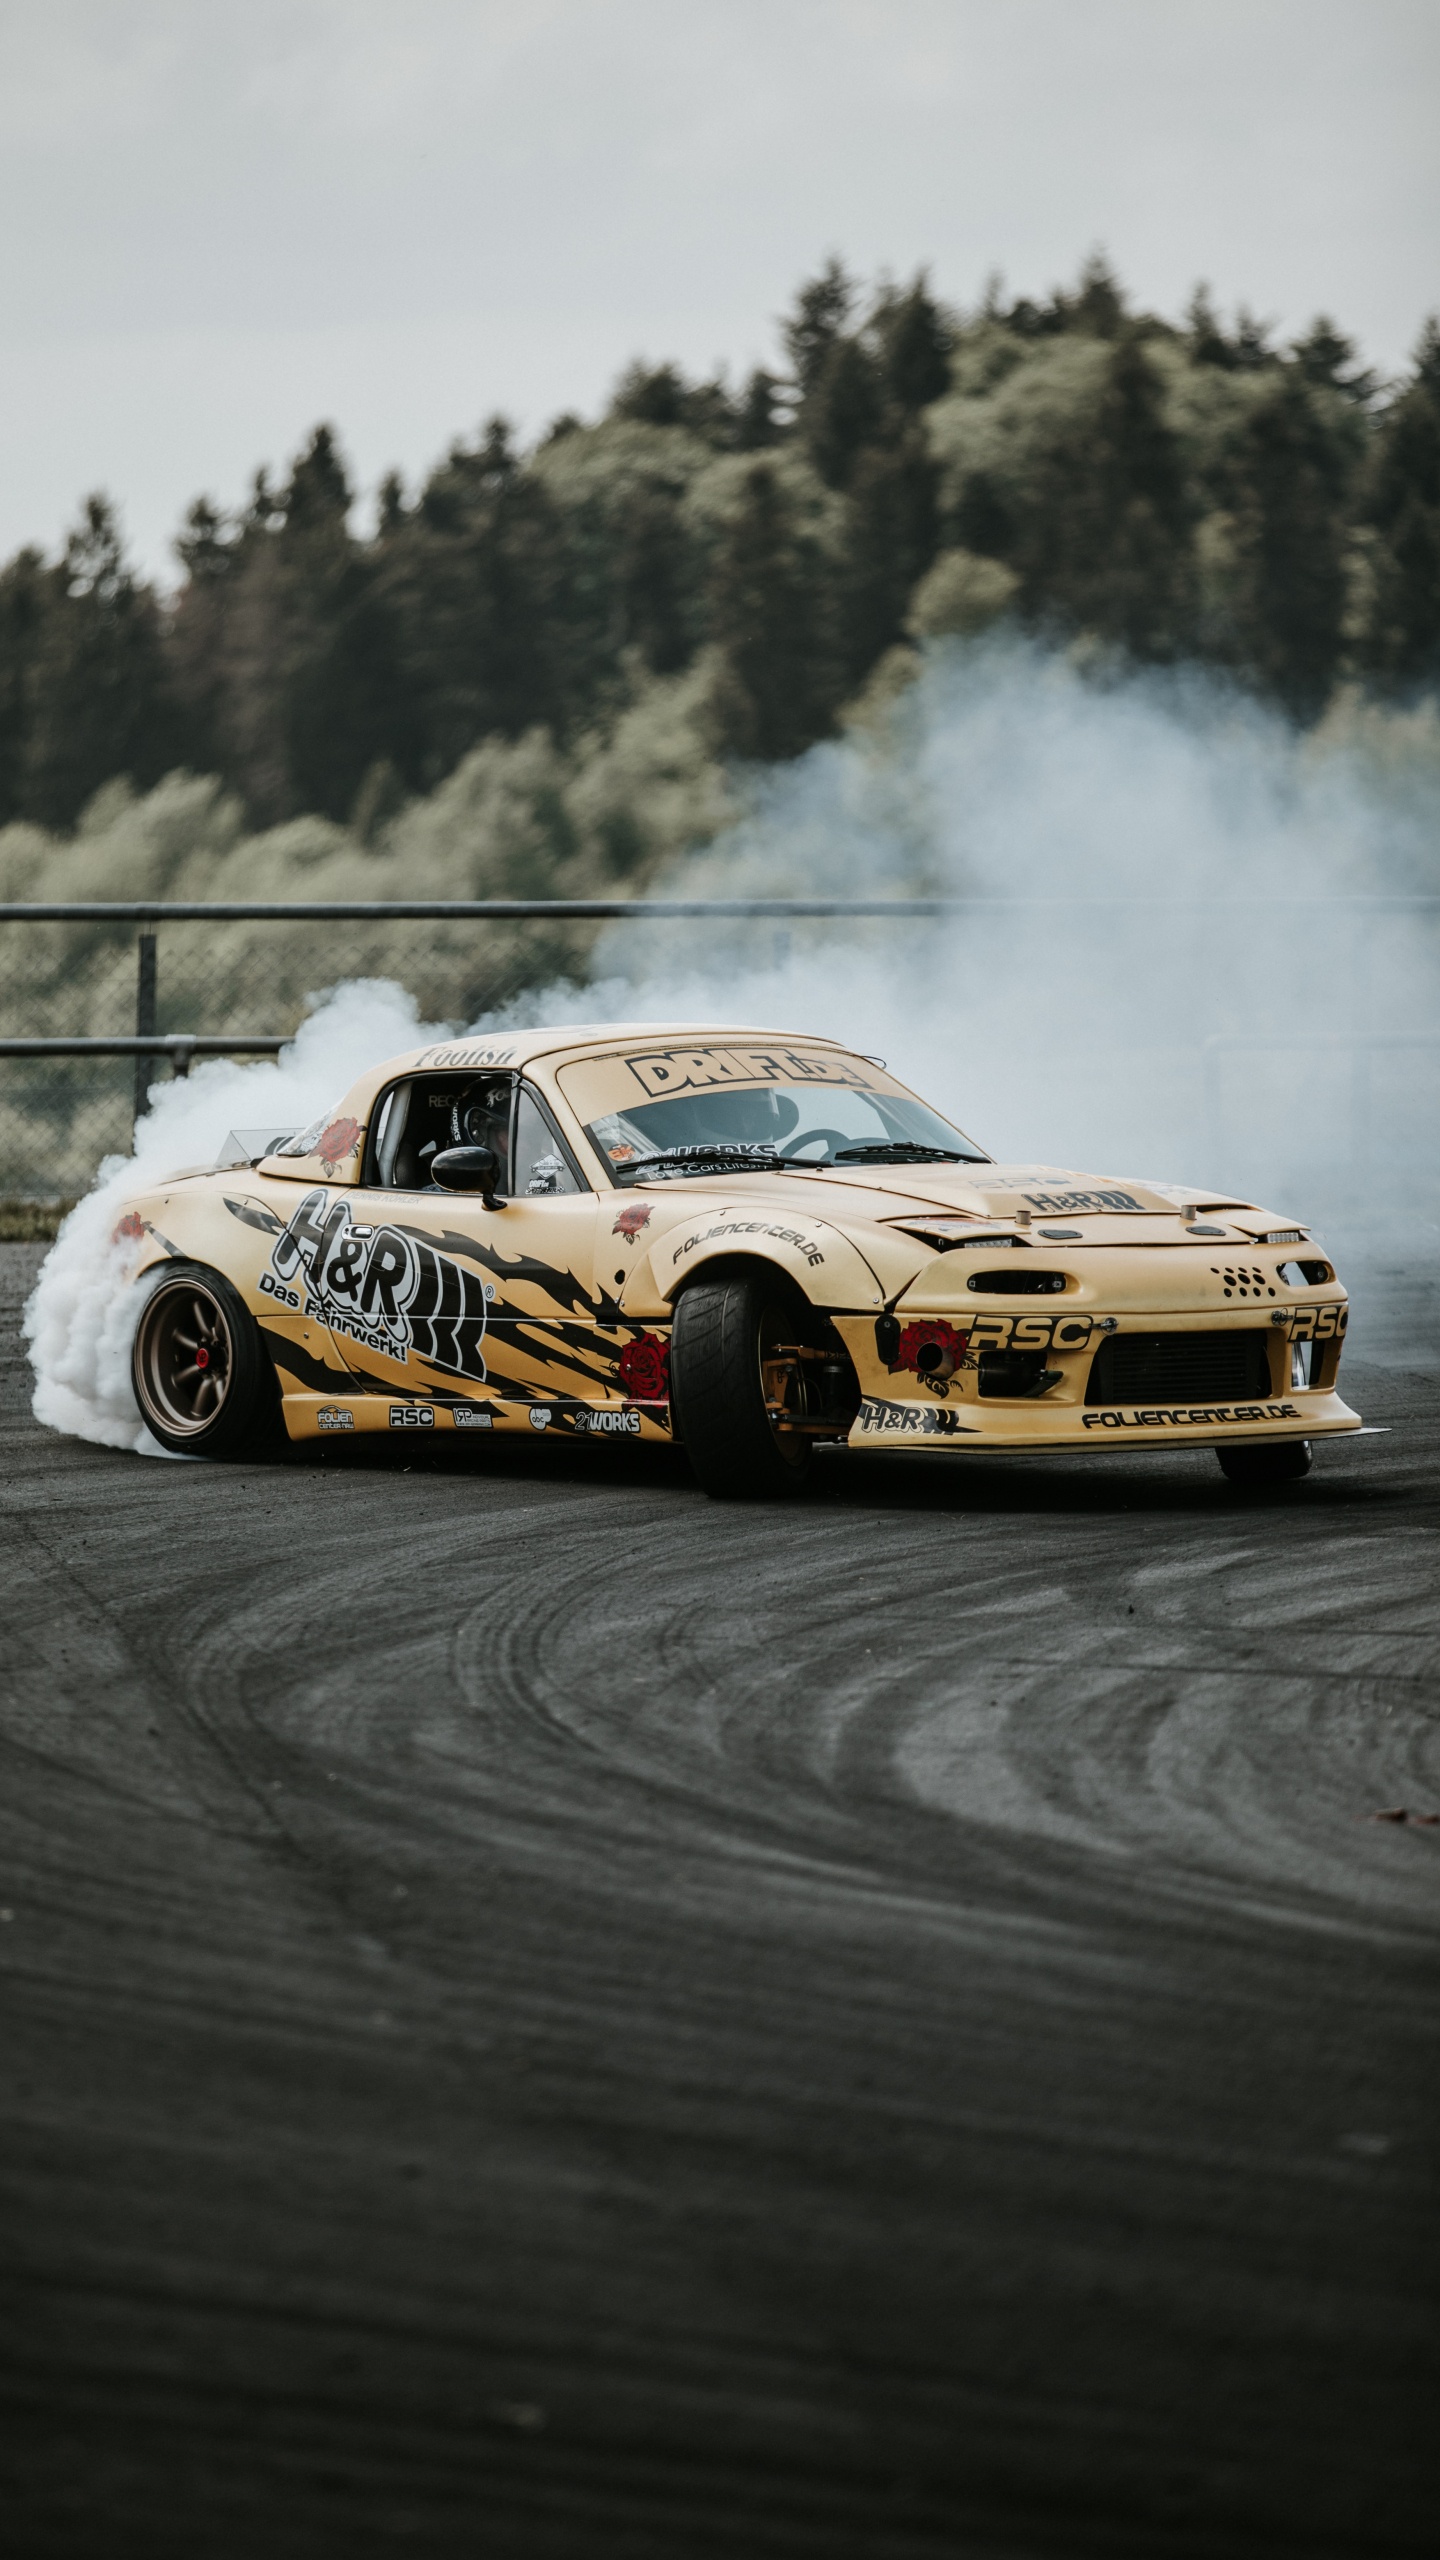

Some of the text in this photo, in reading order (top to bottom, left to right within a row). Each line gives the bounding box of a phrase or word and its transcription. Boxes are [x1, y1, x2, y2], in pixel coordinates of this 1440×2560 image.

[411, 1046, 517, 1068] Foolish
[1021, 1190, 1104, 1213] H&R
[258, 1273, 407, 1363] Das Fahrwerk!
[968, 1316, 1091, 1350] RSC
[391, 1408, 434, 1426] RSC
[574, 1411, 641, 1432] 21WORKS
[861, 1405, 925, 1433] H&R
[1081, 1404, 1303, 1429] FOLIENCENTER.DE
